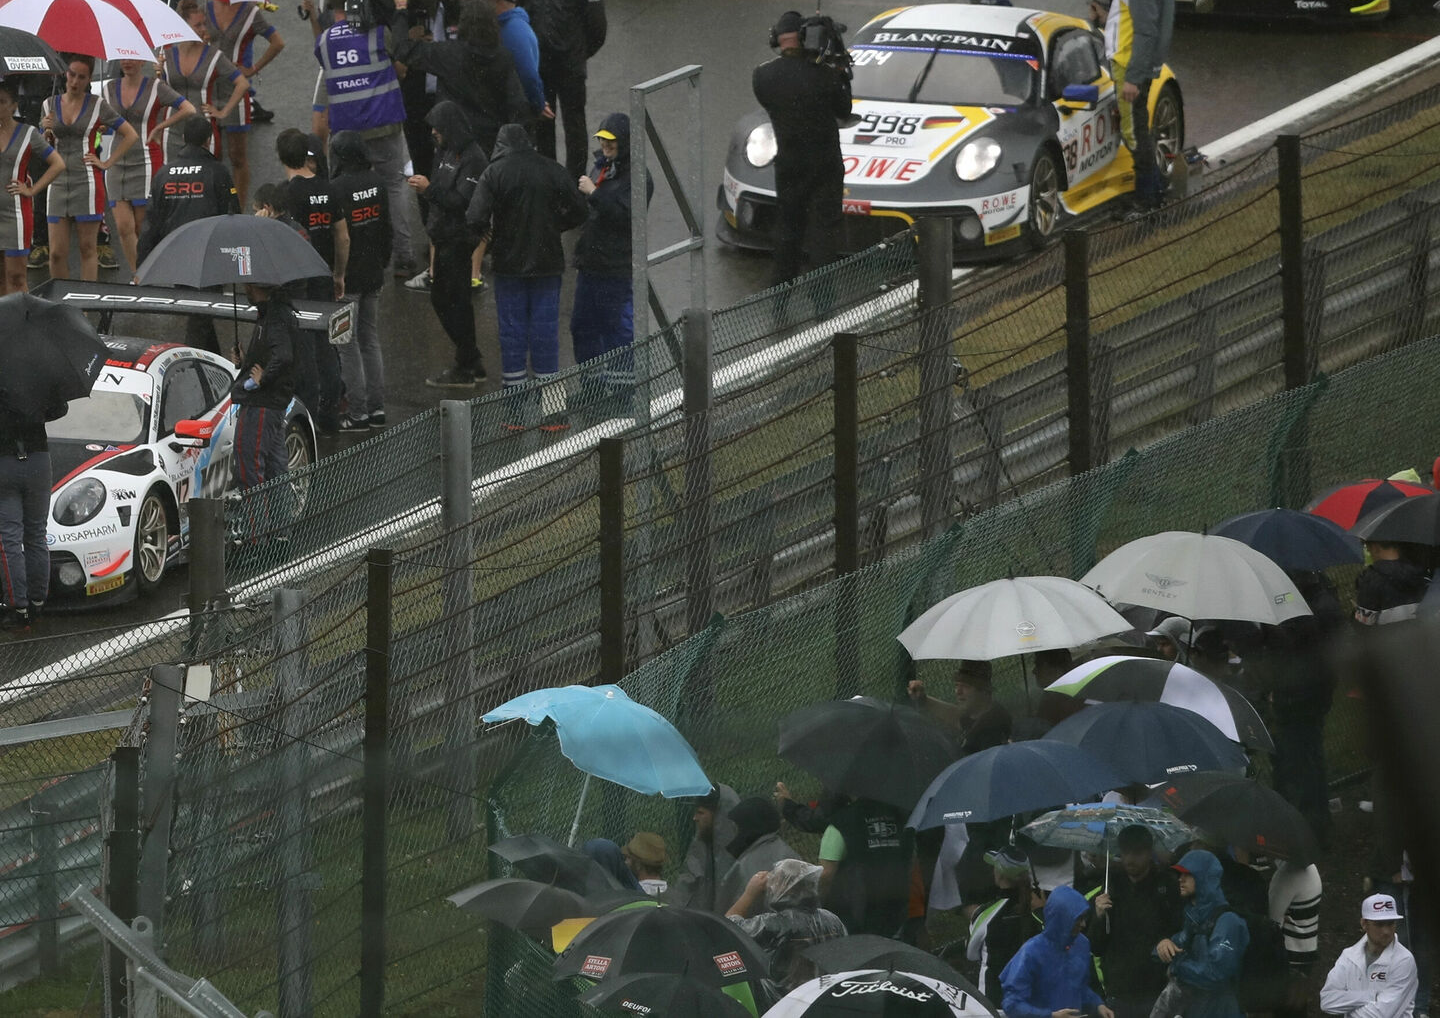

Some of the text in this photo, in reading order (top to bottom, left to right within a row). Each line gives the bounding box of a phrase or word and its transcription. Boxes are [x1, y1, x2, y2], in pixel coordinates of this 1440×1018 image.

[1295, 0, 1329, 8] TOTAL
[871, 32, 1012, 51] BLANCPAIN
[116, 47, 140, 56] TOTAL
[336, 49, 359, 65] 56
[336, 78, 370, 90] TRACK
[858, 114, 923, 136] 998
[884, 135, 908, 147] PRO
[168, 165, 204, 175] STAFF
[843, 156, 923, 181] OWE
[164, 182, 204, 195] SRO
[352, 187, 378, 201] STAFF
[843, 203, 866, 214] TAL
[981, 193, 1018, 211] ROWE
[309, 213, 332, 226] SRO
[62, 292, 323, 325] PORSCE
[116, 489, 136, 500] KW
[58, 524, 118, 543] URSAPHARM
[1142, 587, 1178, 600] BENTLEY
[588, 958, 609, 967] STELLA
[718, 951, 738, 962] STELLA
[585, 964, 606, 972] ARTOIS
[720, 958, 742, 969] ARTOIS
[831, 980, 935, 1003] Titleist
